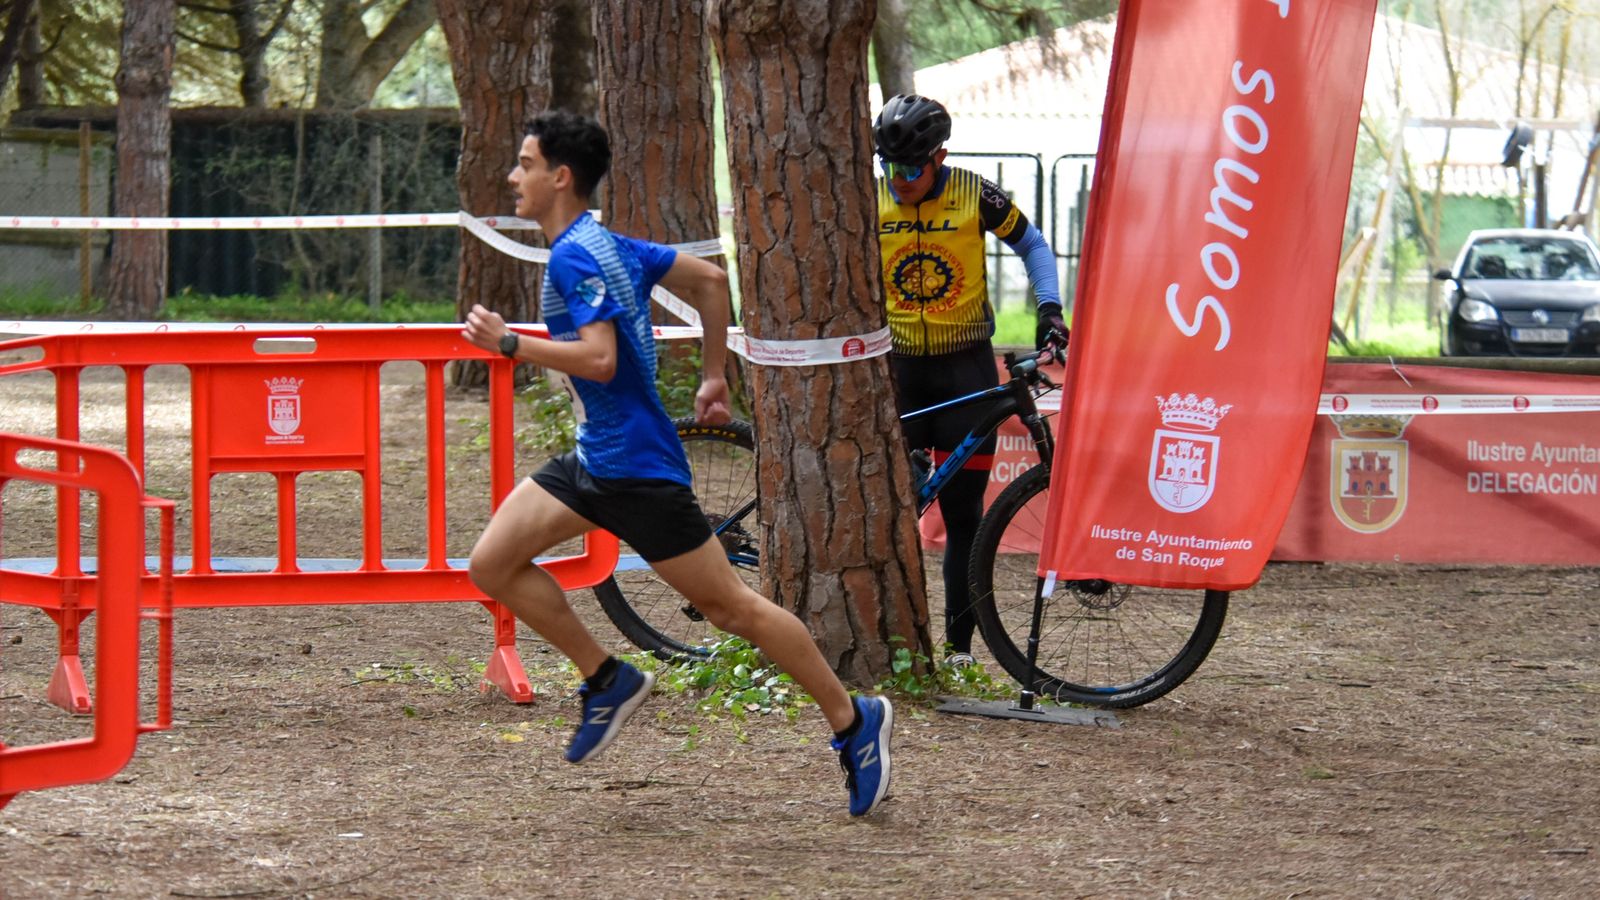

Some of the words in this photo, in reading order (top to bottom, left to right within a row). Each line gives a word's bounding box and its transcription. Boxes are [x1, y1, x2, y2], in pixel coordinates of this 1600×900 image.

[1165, 60, 1275, 352] Somos
[879, 220, 958, 235] SPALL
[678, 428, 737, 439] MAXXIS
[995, 433, 1038, 456] yunt
[1467, 440, 1526, 461] Ilustre
[1530, 441, 1600, 468] Ayunta
[989, 457, 1037, 483] CIÓ
[1467, 468, 1598, 495] DELEGACIÓN
[1091, 524, 1142, 542] Ilustre
[1146, 529, 1252, 551] Ayuntamiento
[1115, 546, 1136, 560] de
[1141, 548, 1173, 564] San
[1178, 552, 1225, 570] Roque
[588, 706, 614, 725] N
[856, 741, 879, 770] N
